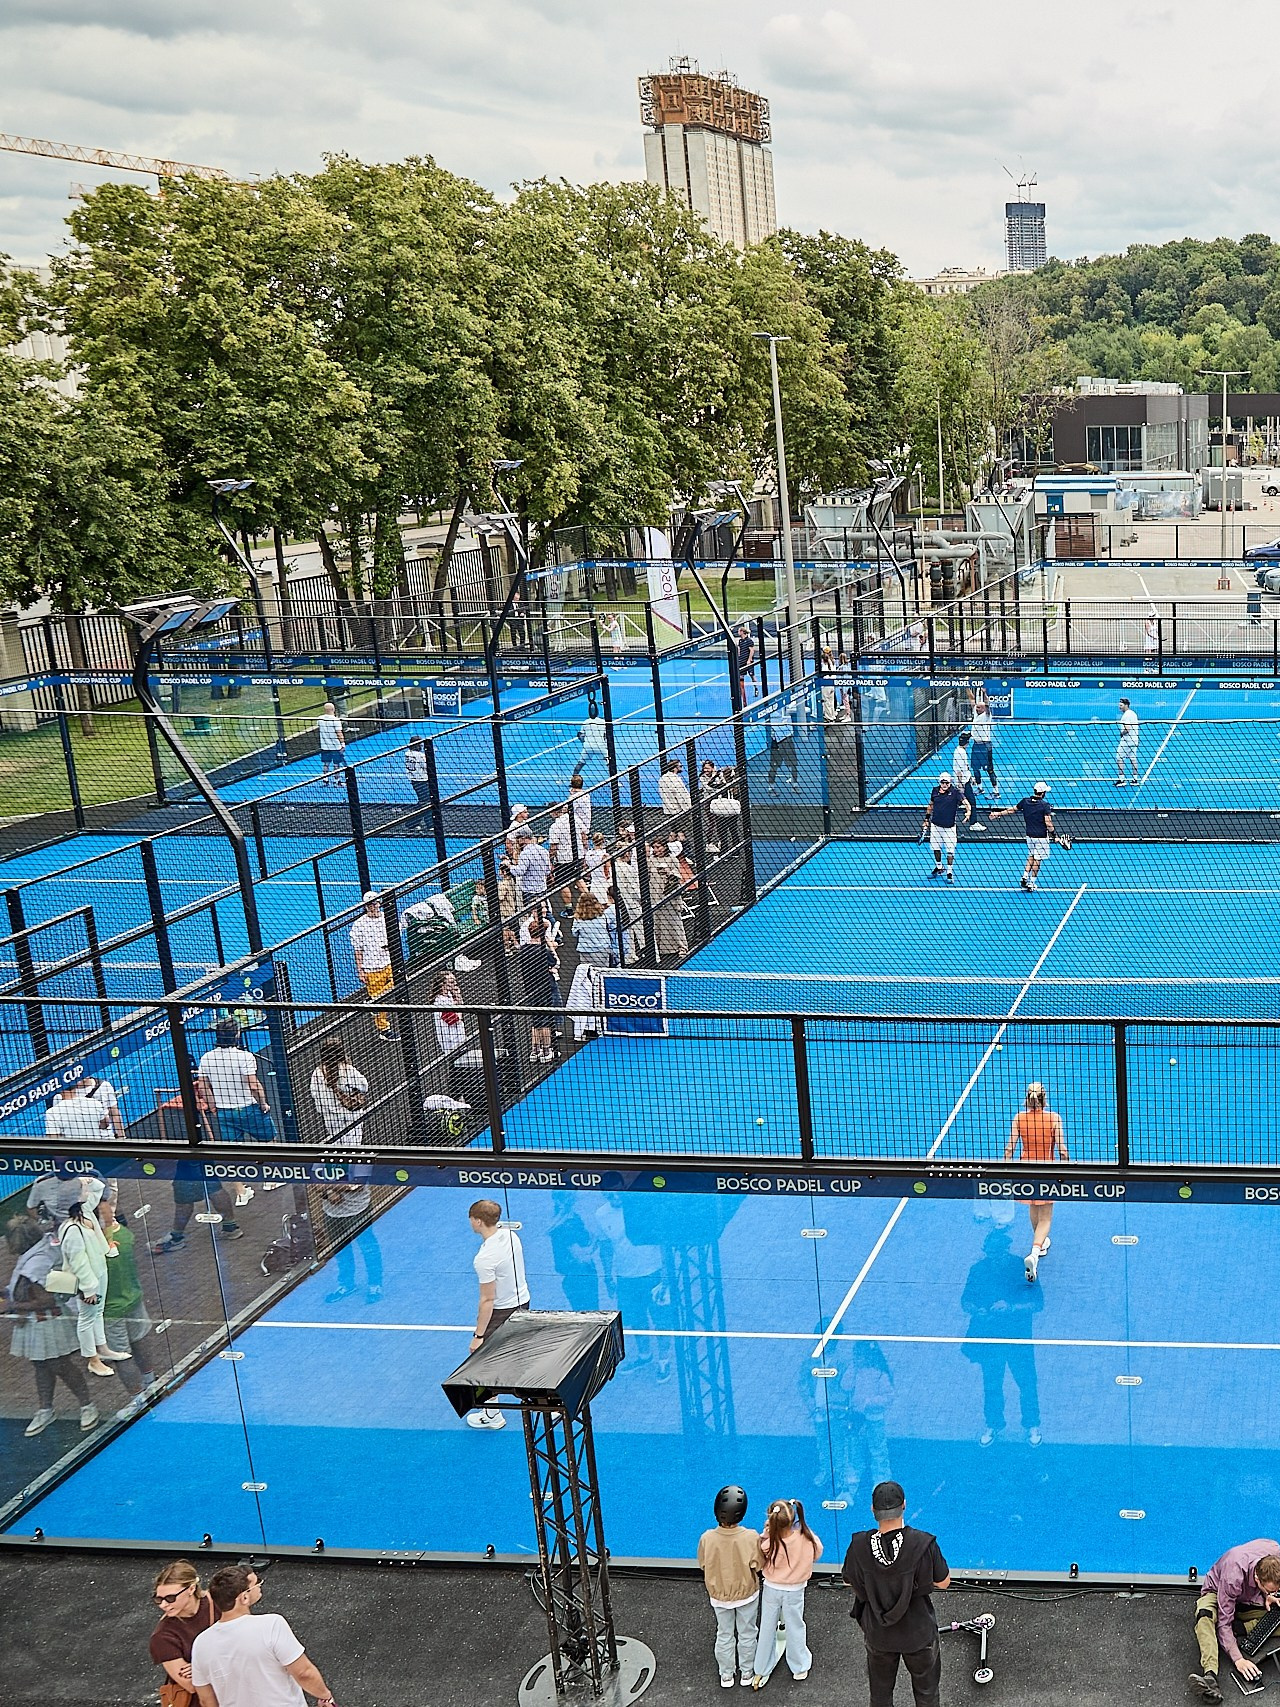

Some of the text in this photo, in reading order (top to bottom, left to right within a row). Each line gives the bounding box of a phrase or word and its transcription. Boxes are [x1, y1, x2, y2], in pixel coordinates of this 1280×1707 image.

[608, 994, 657, 1007] BOSCO
[145, 1020, 171, 1041] BOSC
[0, 1065, 84, 1119] OSCO PADEL CUP
[14, 1159, 60, 1172] PADEL
[65, 1161, 94, 1173] CUP
[204, 1164, 345, 1180] BOSCO PADEL CUP
[458, 1170, 602, 1187] BOSCO PADEL CUP
[717, 1177, 862, 1193] BOSCO PADEL CUP
[978, 1182, 1126, 1198] BOSCO PADEL CUP
